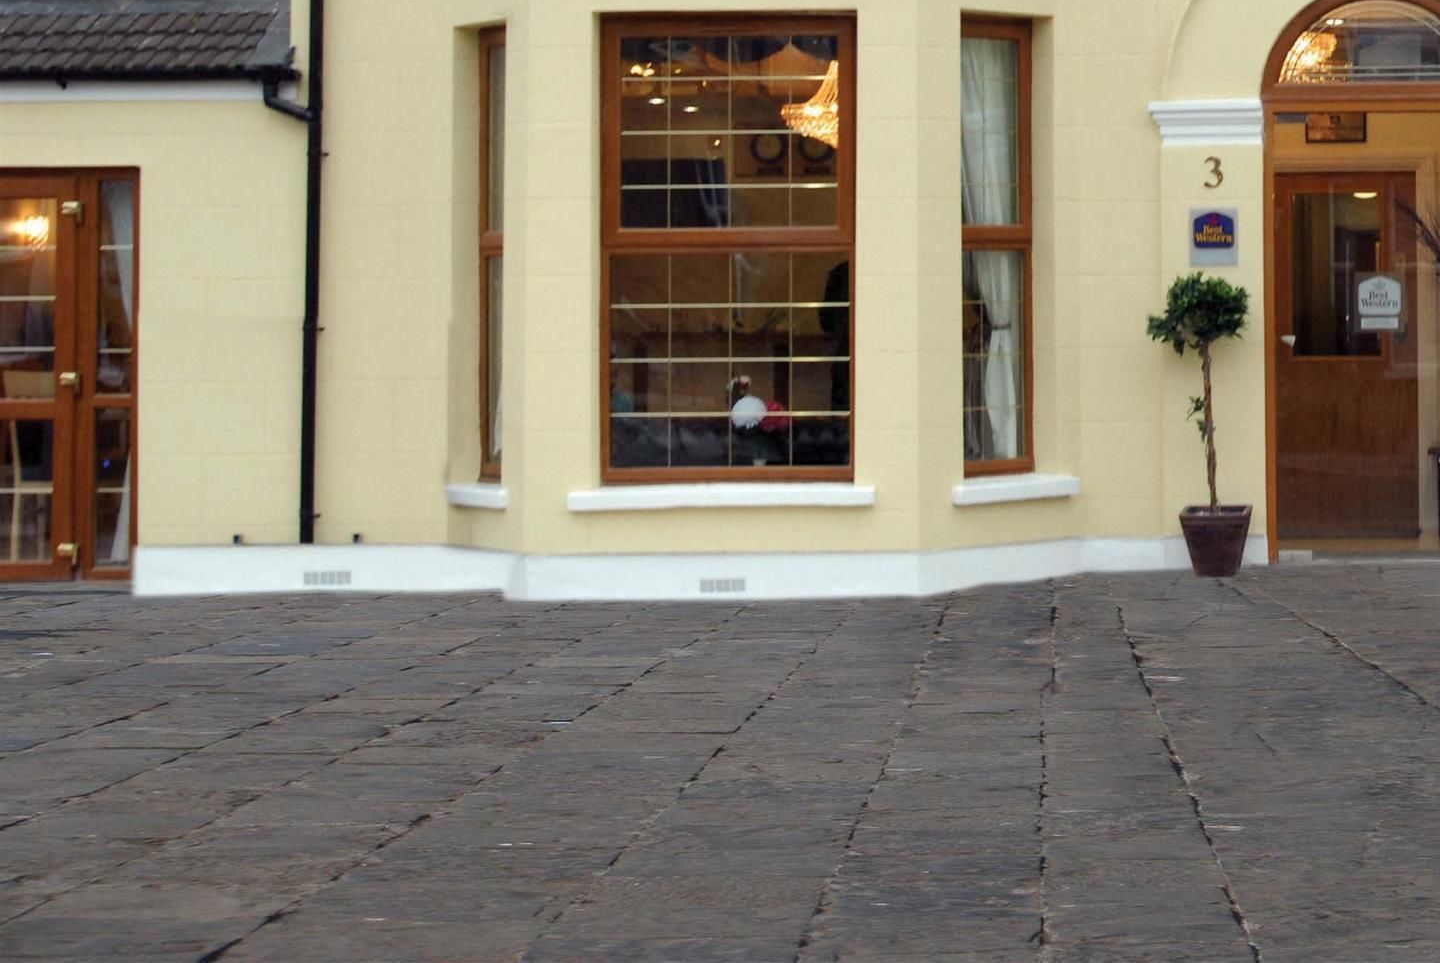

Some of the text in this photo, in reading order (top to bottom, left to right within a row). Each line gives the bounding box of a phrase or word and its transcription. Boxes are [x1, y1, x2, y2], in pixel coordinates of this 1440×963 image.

[1204, 156, 1224, 188] 3
[1203, 224, 1223, 234] Best
[1195, 233, 1233, 243] Western
[1369, 291, 1388, 300] Best
[1361, 297, 1398, 308] Western
